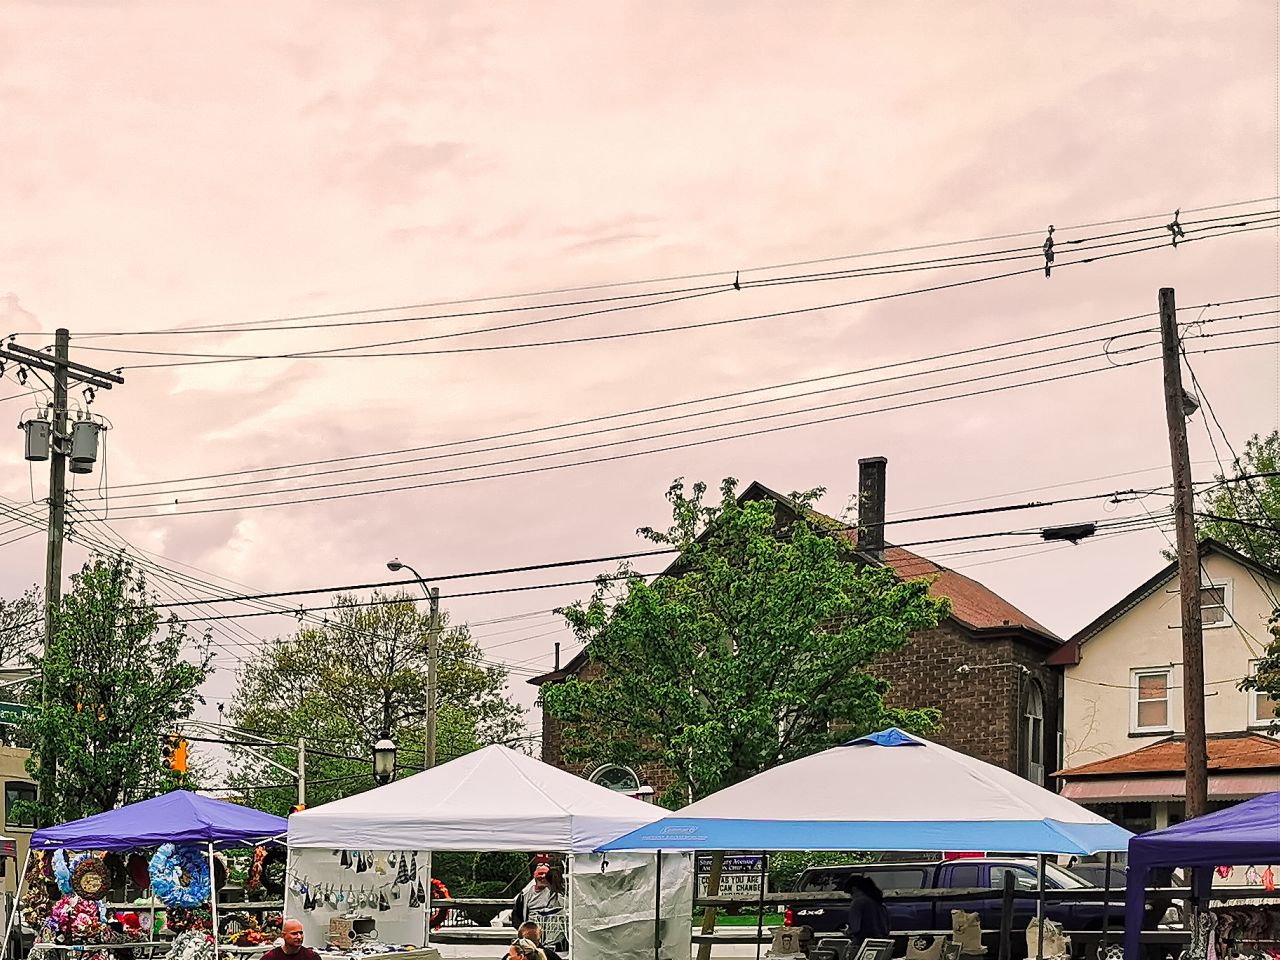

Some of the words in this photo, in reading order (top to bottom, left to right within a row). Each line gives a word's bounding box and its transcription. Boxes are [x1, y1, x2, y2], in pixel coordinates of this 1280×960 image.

[720, 876, 730, 884] AS
[732, 876, 744, 884] YOU
[746, 876, 759, 884] ARE
[720, 884, 732, 892] CAN
[797, 908, 824, 916] 4x4
